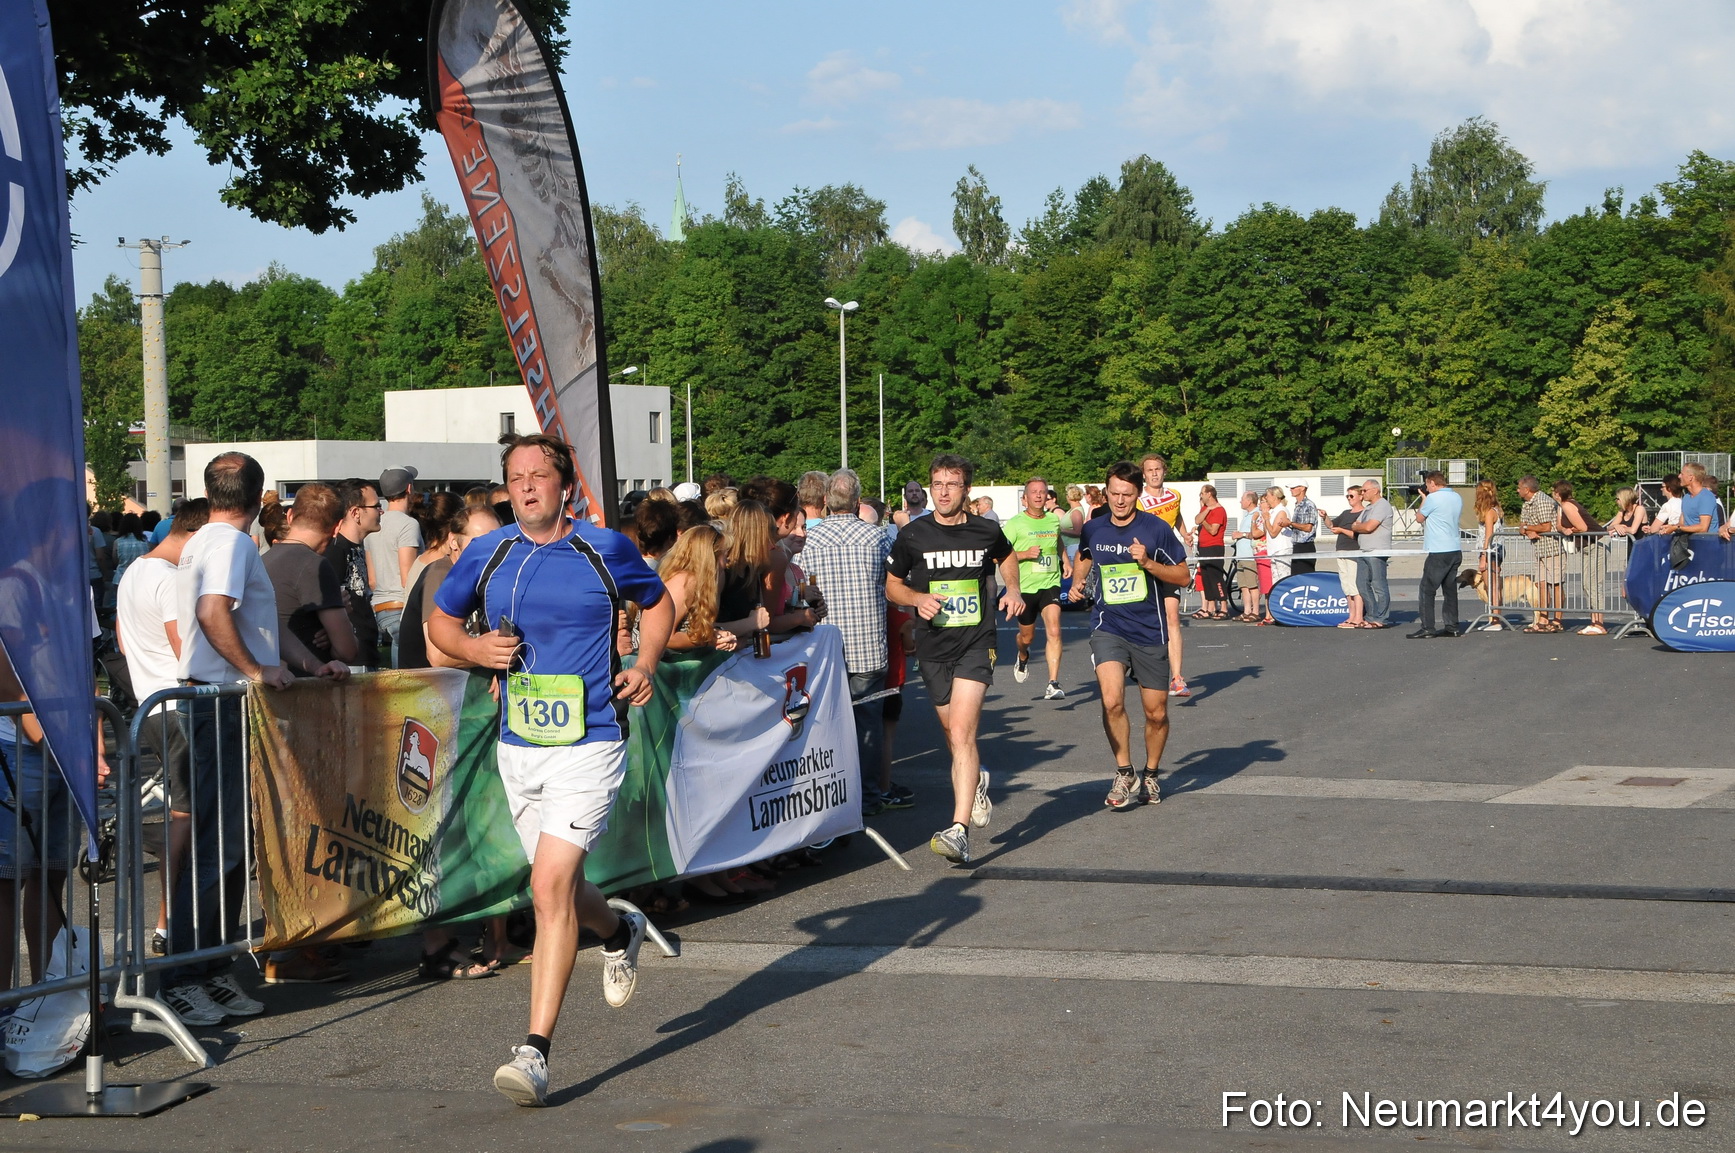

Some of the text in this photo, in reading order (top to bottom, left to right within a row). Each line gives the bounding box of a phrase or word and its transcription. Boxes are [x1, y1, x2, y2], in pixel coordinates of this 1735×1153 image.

[923, 549, 985, 570] THULE
[1038, 555, 1052, 567] 40
[1108, 576, 1138, 594] 327
[1293, 595, 1348, 609] Fische
[1687, 612, 1735, 629] Fisc
[517, 697, 570, 728] 130
[403, 785, 424, 806] 1628
[749, 772, 848, 832] Lammsbräu
